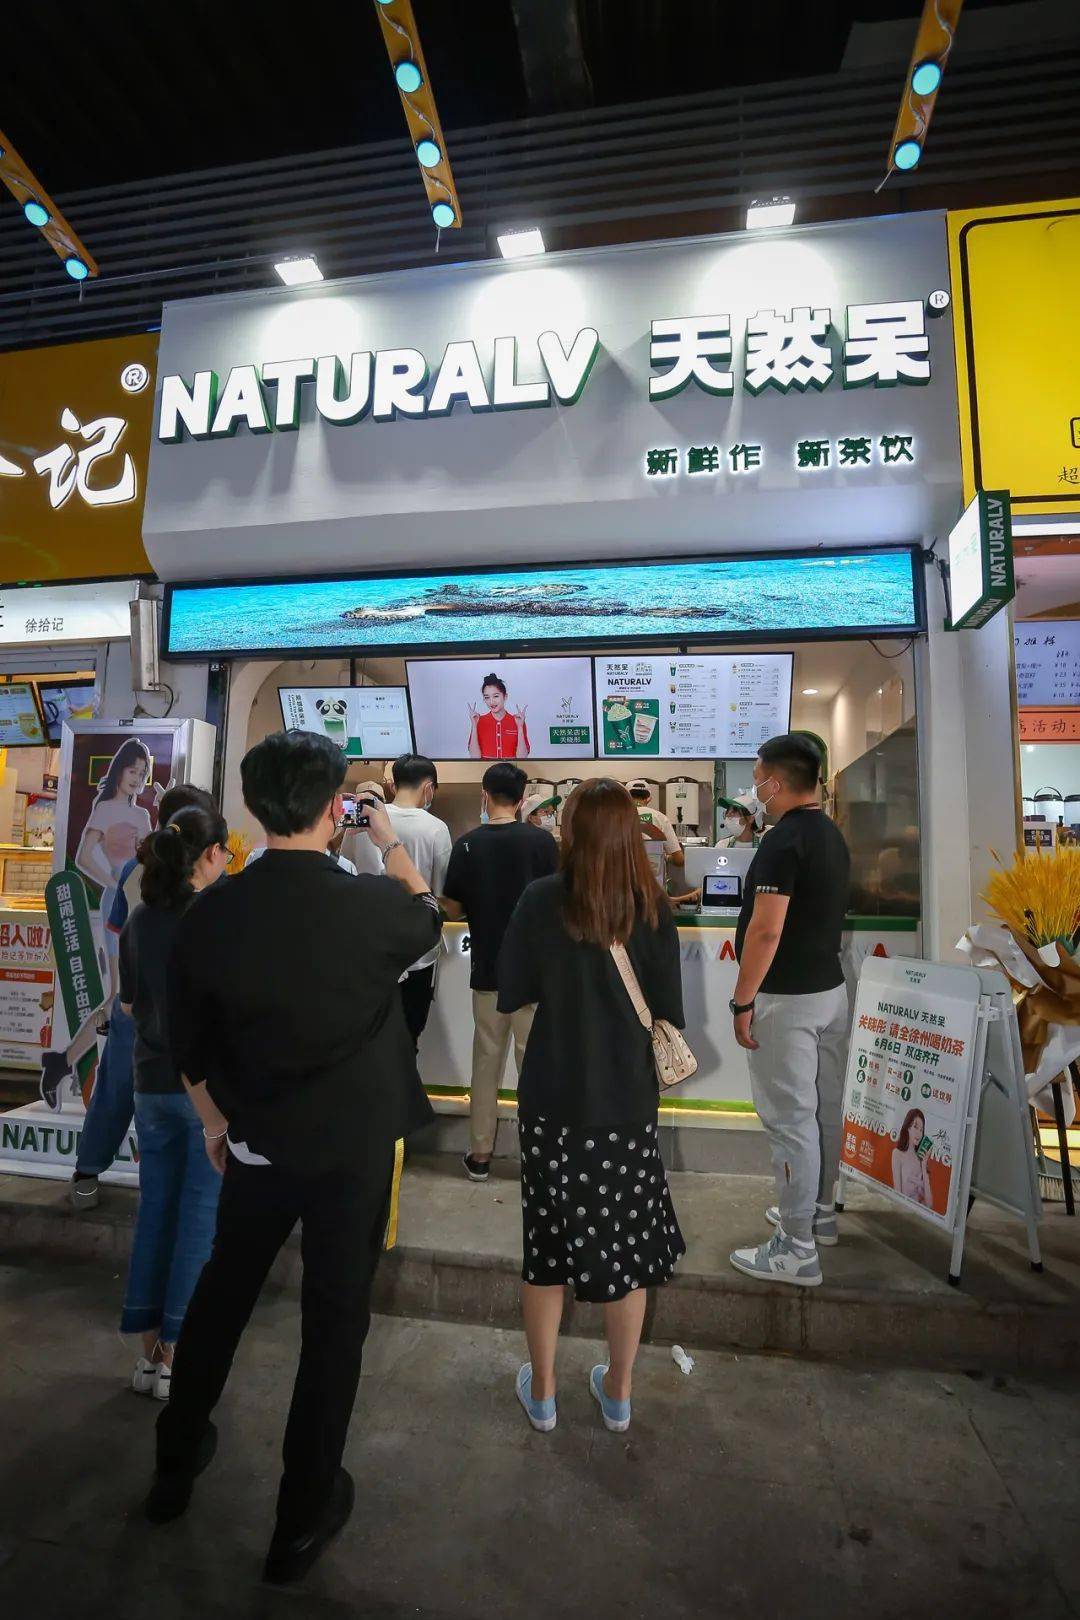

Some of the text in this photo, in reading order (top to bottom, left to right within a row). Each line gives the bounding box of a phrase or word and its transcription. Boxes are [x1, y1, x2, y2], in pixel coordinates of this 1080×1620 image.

[649, 299, 931, 402] 天然呆
[158, 327, 600, 445] NATURALV
[0, 408, 137, 510] 记
[646, 435, 915, 476] 新鲜作 新茶饮
[1058, 466, 1080, 485] 超
[987, 498, 1008, 587] NATURALV
[25, 617, 64, 634] 徐拾记
[608, 678, 652, 686] NATURALV
[858, 1014, 888, 1034] 关晓彤
[888, 1022, 965, 1056] 请全徐州喝奶茶
[877, 1001, 946, 1028] NATURALV 天然呆
[874, 1036, 901, 1054] 6月6日
[904, 1045, 940, 1067] 双店齐开
